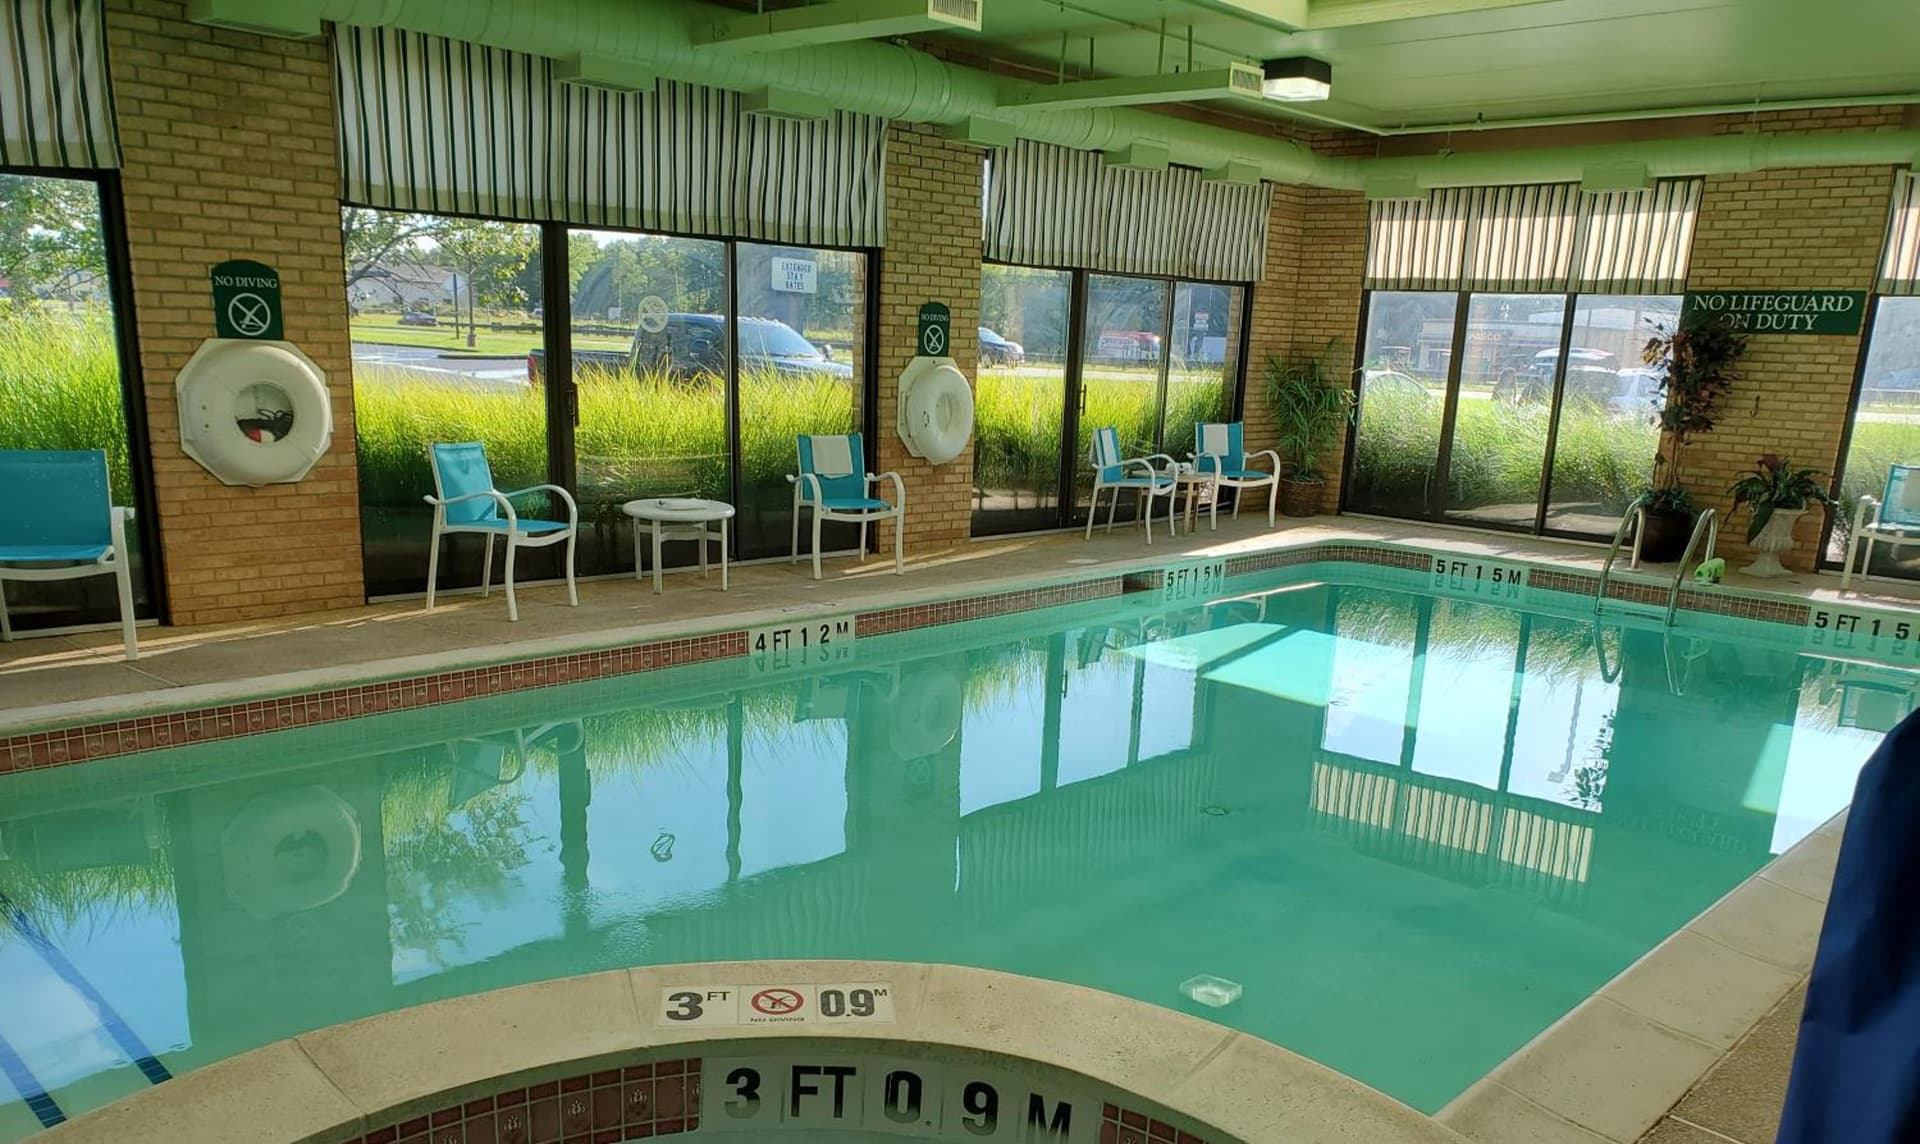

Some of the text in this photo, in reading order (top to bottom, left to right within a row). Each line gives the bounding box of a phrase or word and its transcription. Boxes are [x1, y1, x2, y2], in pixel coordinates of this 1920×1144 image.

[214, 275, 278, 289] NO DIVING
[786, 271, 804, 281] STAY
[1692, 294, 1853, 312] NO LIFEGUARD
[920, 313, 949, 322] NO DIVING
[1719, 312, 1819, 330] ON DUTY
[1167, 571, 1174, 587] 5
[1177, 568, 1189, 585] FT
[1436, 559, 1446, 574] 5
[1451, 561, 1469, 577] FT
[1508, 569, 1522, 585] M
[1814, 611, 1829, 628] 5
[1836, 613, 1861, 632] FT
[755, 633, 766, 651] 4
[773, 629, 792, 651] FT
[836, 621, 849, 634] M
[874, 988, 887, 997] M
[666, 991, 731, 1021] 3 FT
[725, 1067, 761, 1119] 3
[791, 1065, 856, 1119] FT
[1027, 1092, 1072, 1144] M
